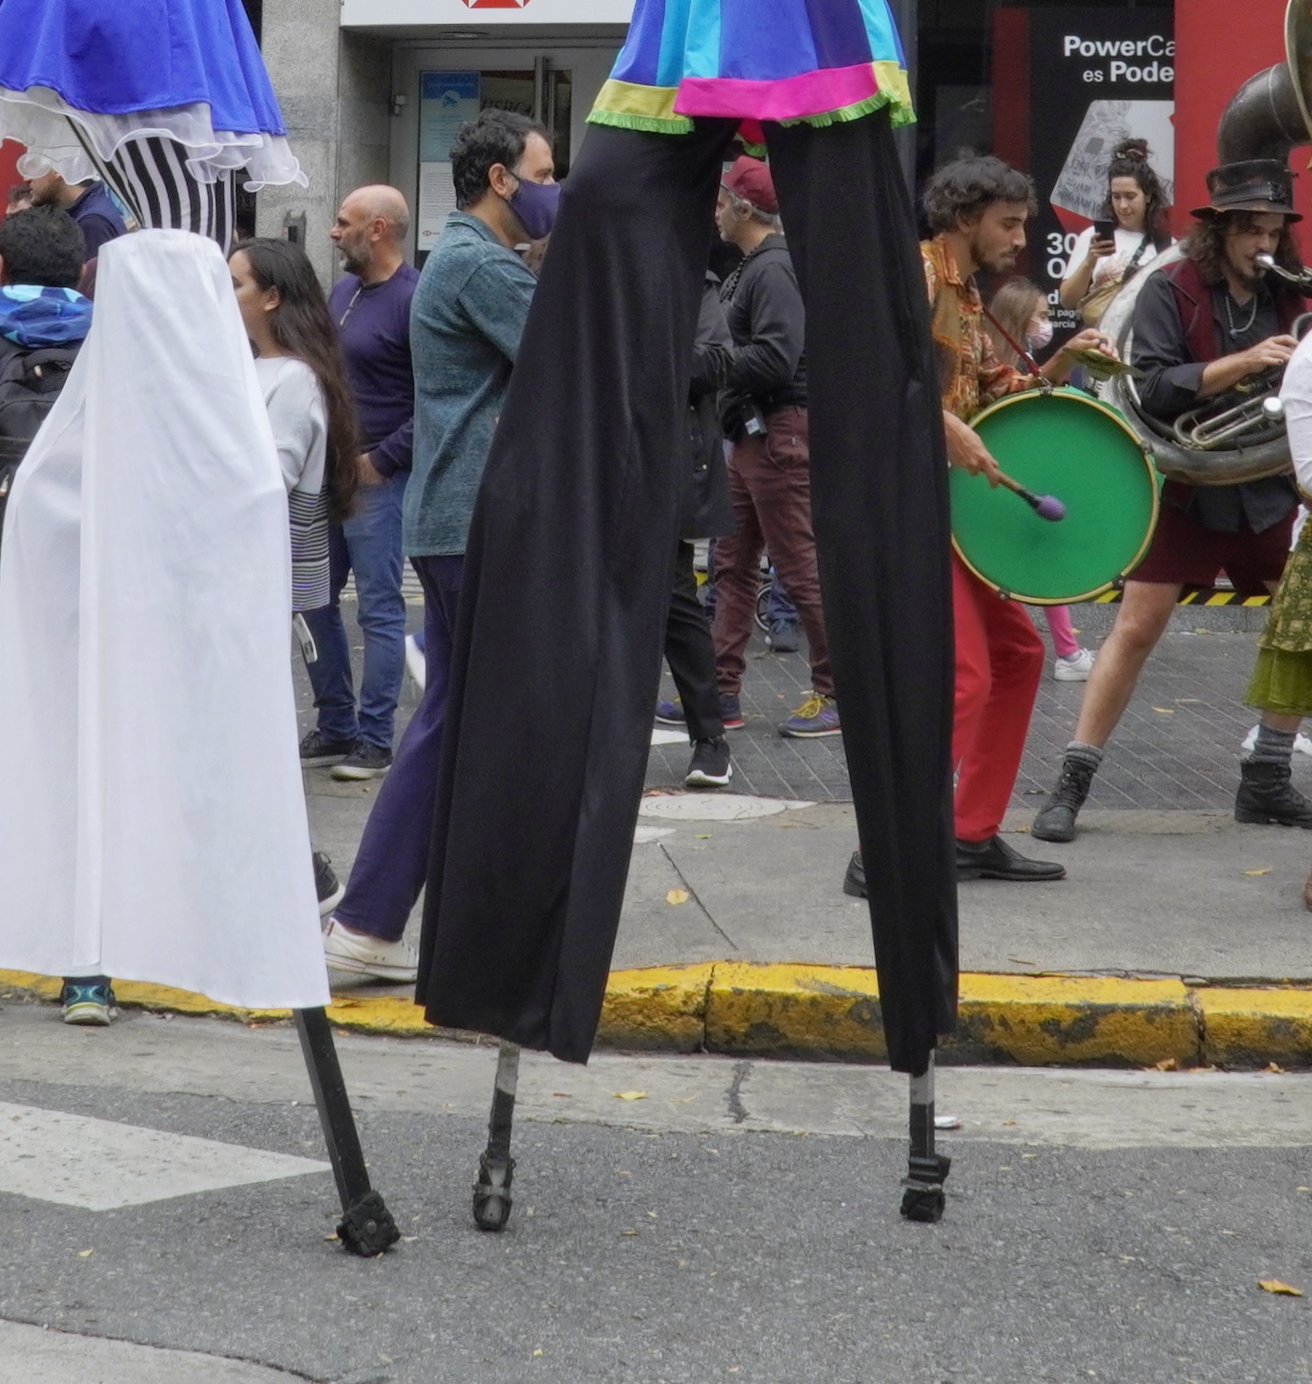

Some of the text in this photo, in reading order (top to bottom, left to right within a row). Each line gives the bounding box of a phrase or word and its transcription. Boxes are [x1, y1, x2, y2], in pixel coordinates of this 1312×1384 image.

[1064, 35, 1175, 57] PowerCa
[1082, 61, 1175, 83] es Pode
